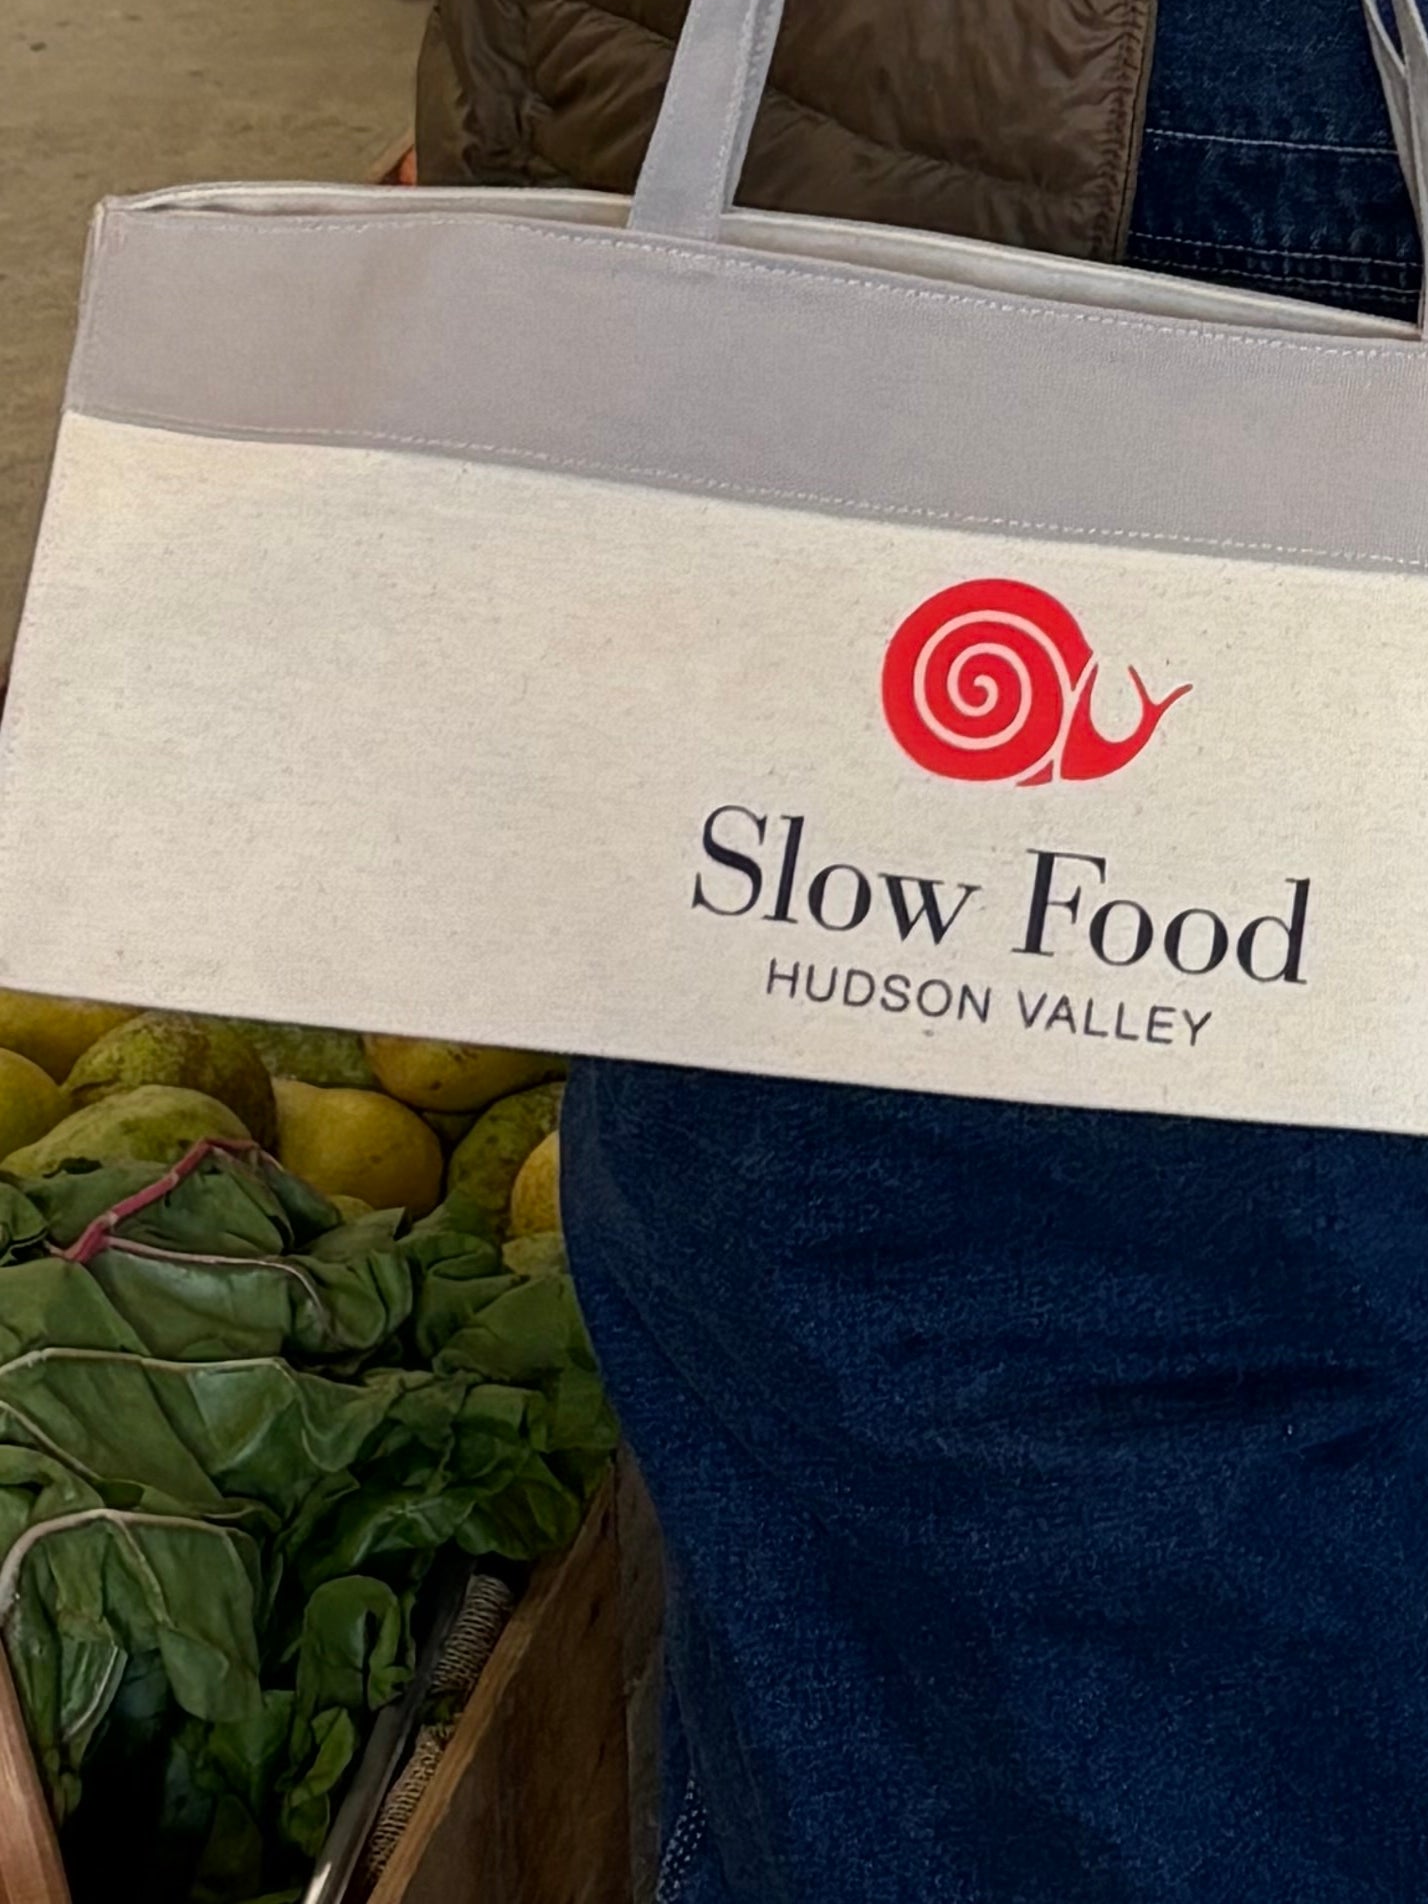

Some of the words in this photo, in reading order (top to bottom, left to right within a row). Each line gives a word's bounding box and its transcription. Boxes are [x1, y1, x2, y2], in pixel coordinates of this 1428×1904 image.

[691, 804, 982, 946] Slow
[1010, 848, 1312, 986] Food
[765, 957, 992, 1026] HUDSON
[1016, 989, 1213, 1047] VALLEY
